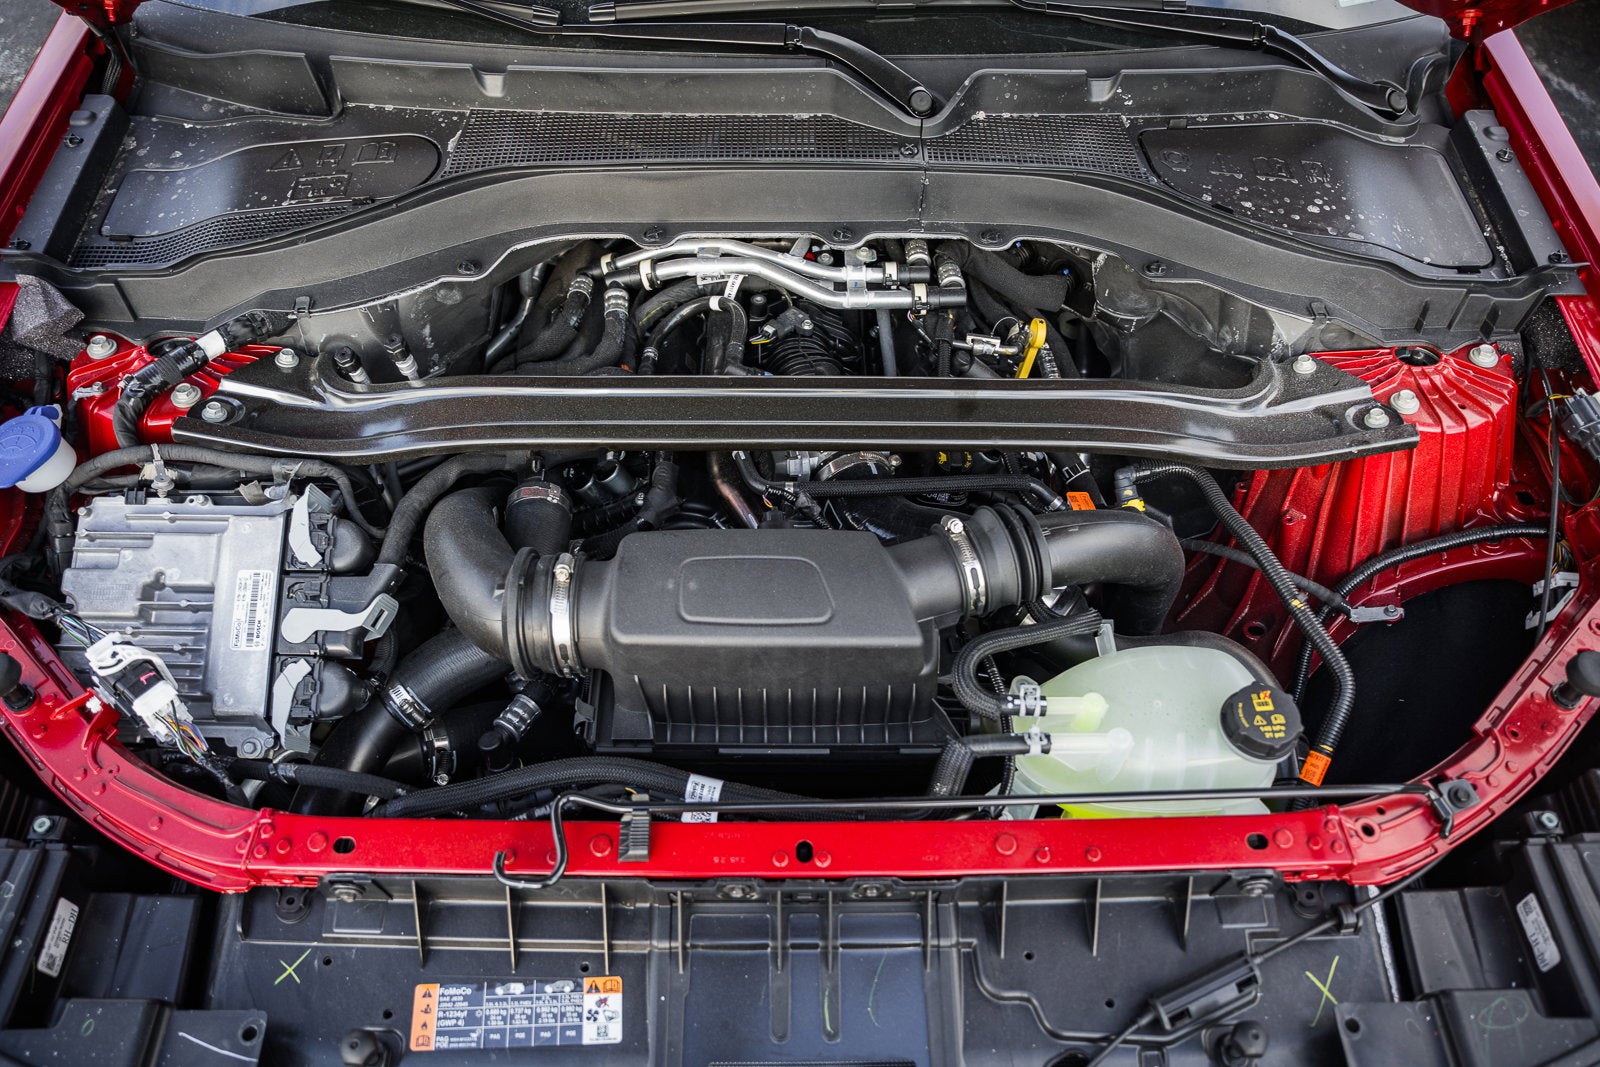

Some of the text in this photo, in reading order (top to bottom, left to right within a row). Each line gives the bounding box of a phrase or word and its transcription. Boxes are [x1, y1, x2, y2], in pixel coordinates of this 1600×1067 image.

[440, 987, 472, 995] FoMoCo
[438, 1010, 468, 1018] R-1234yf
[438, 1019, 457, 1027] (GWP
